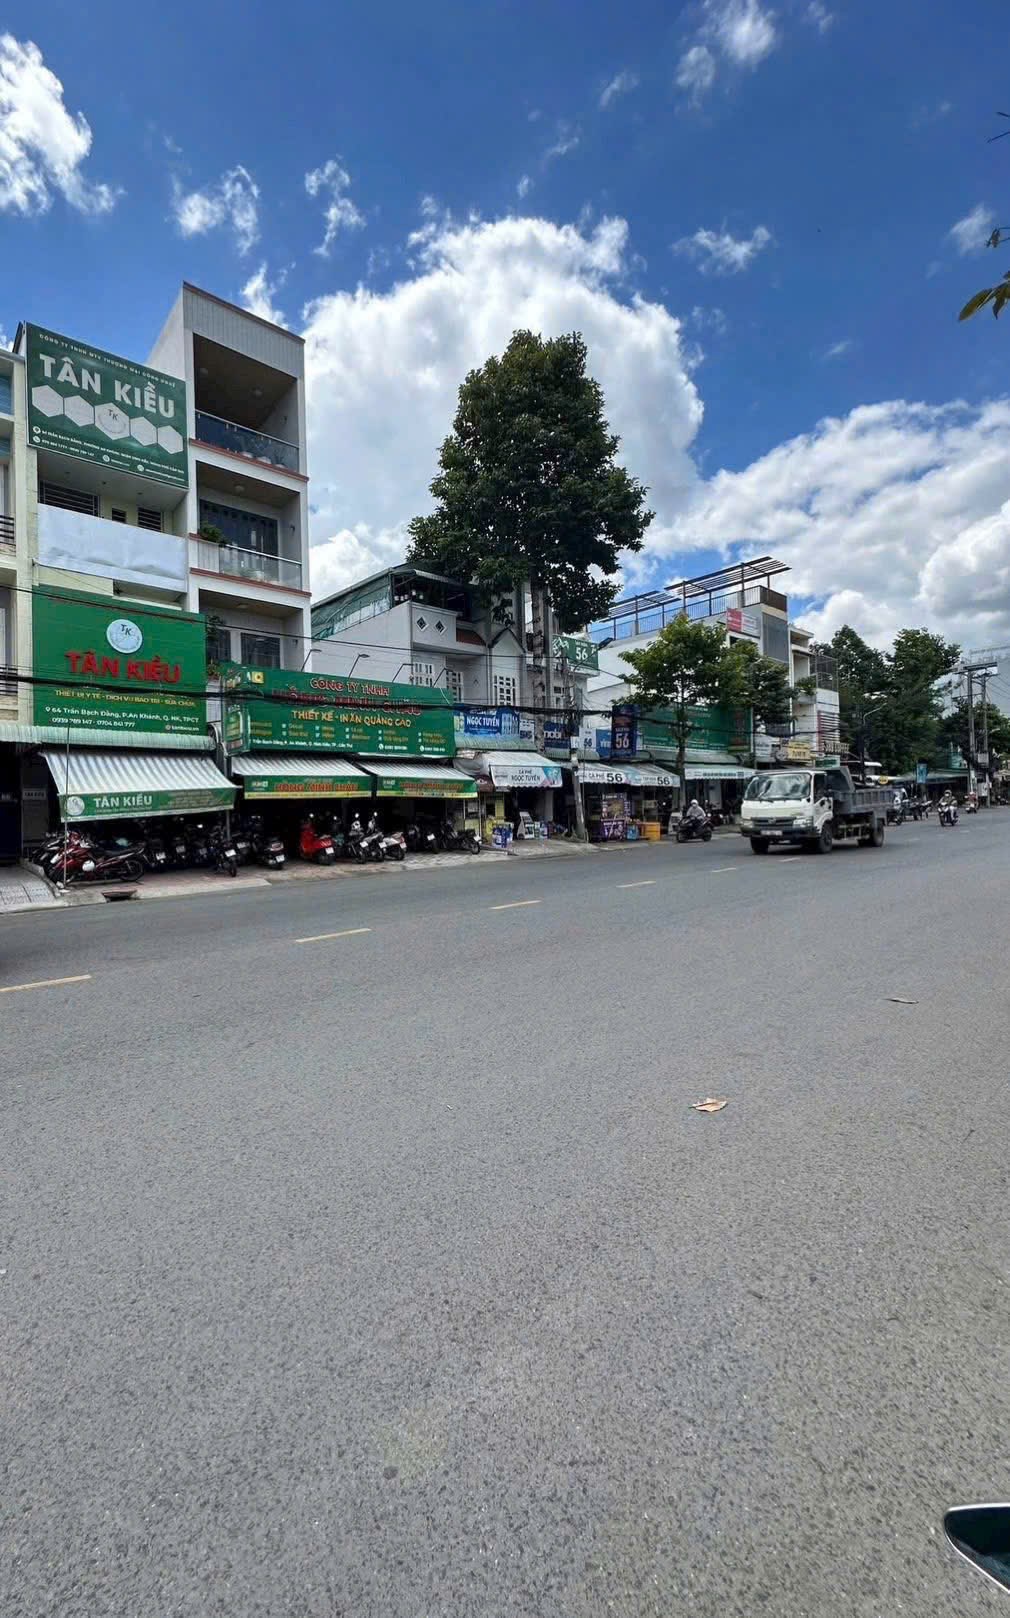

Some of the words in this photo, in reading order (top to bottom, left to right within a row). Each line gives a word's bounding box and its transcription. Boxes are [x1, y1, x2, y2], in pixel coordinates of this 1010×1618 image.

[39, 353, 101, 395] TÂN
[114, 381, 175, 418] KIỀU
[107, 408, 119, 421] TK
[120, 623, 132, 636] TK
[575, 646, 588, 660] 56
[65, 650, 120, 678] TÂN
[126, 655, 182, 684] KIỀU
[310, 676, 344, 692] CÔNG
[346, 681, 360, 693] TY
[361, 683, 390, 696] TNHH
[80, 708, 100, 716] Bạch
[466, 715, 482, 728] NGỌC
[615, 732, 630, 749] 56
[606, 772, 623, 783] 56
[657, 777, 671, 785] 56
[93, 796, 120, 808] TÂN
